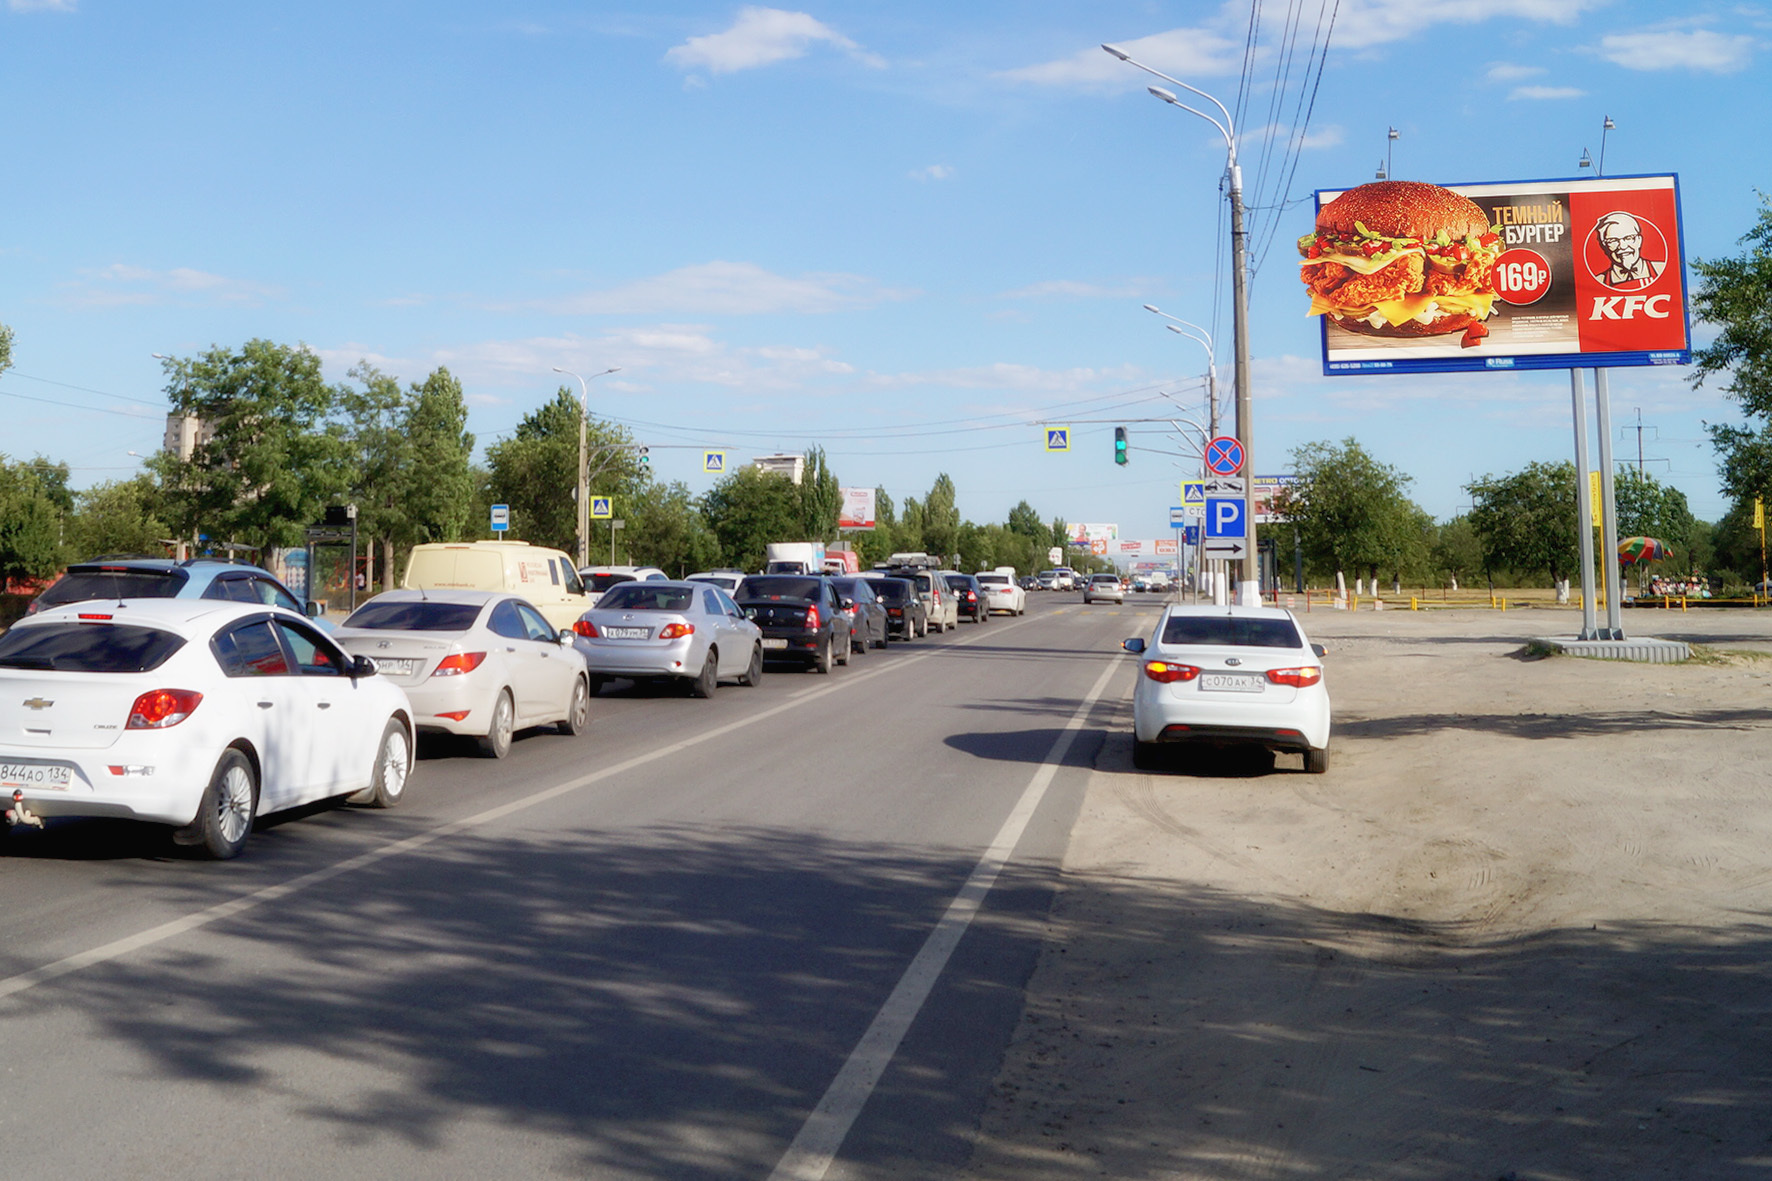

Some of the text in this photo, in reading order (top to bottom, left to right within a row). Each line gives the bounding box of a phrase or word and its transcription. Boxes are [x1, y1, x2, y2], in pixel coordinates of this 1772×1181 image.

[1492, 200, 1563, 225] ТЕМНЫЙ
[1505, 223, 1565, 244] БУРГЕР
[1588, 294, 1671, 321] KFC
[1216, 501, 1239, 534] P
[48, 767, 67, 780] 134
